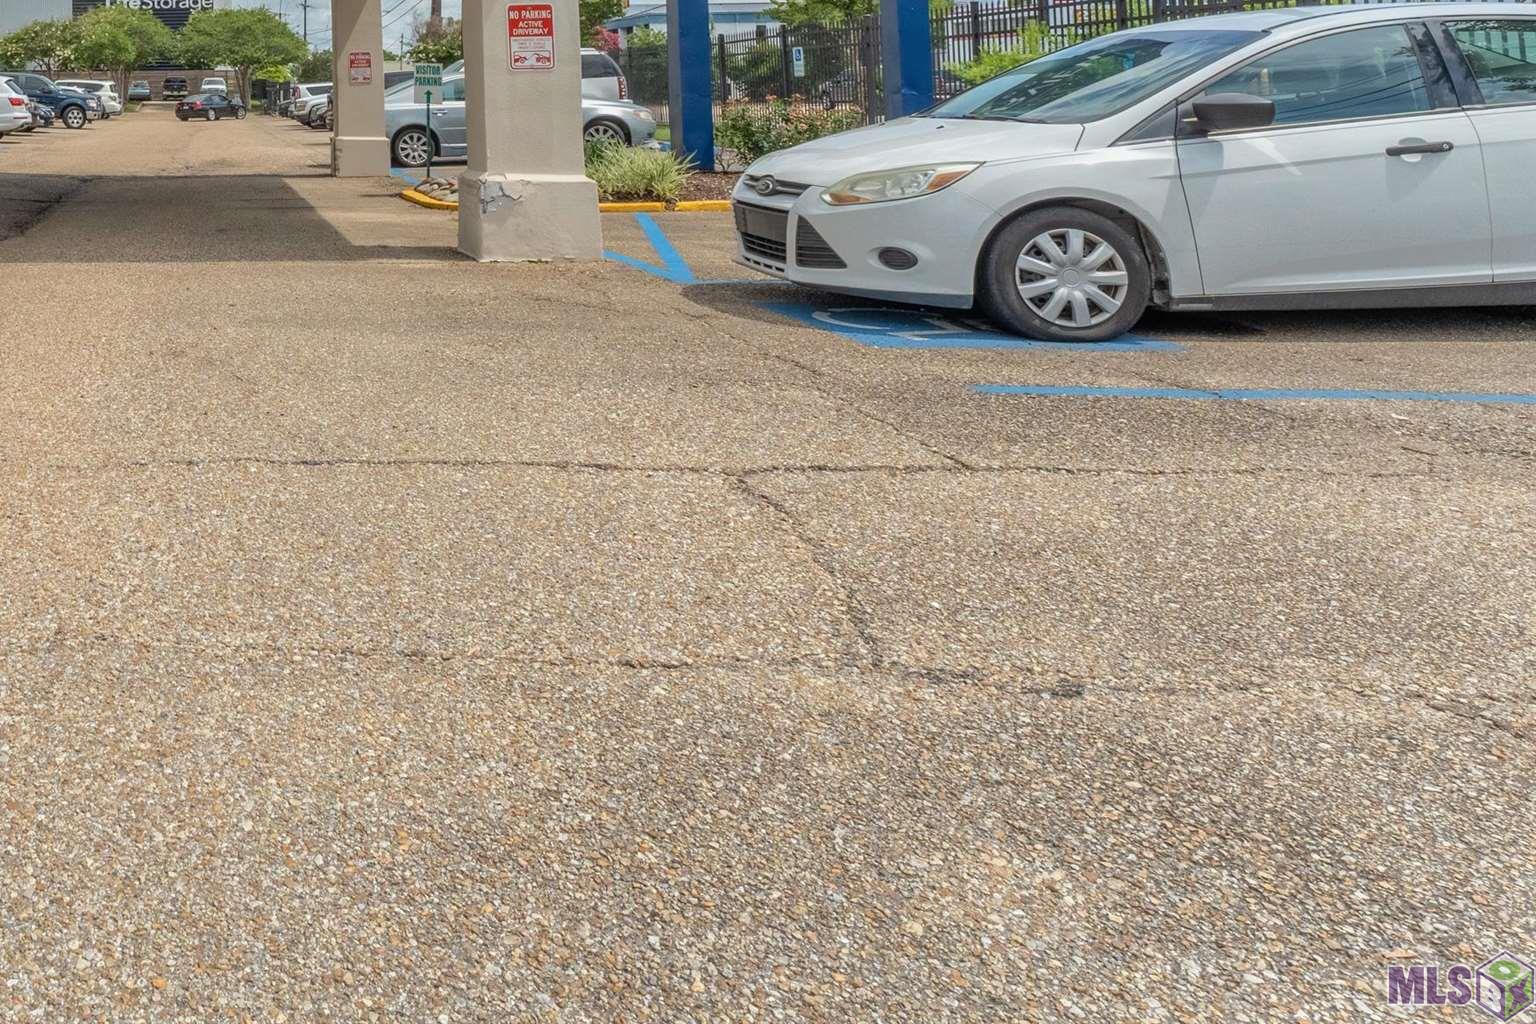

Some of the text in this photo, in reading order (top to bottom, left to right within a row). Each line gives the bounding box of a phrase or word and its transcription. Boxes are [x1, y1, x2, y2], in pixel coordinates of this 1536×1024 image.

[509, 10, 552, 20] NO PARKING
[415, 64, 441, 75] VISITOR
[415, 76, 442, 86] PARKING
